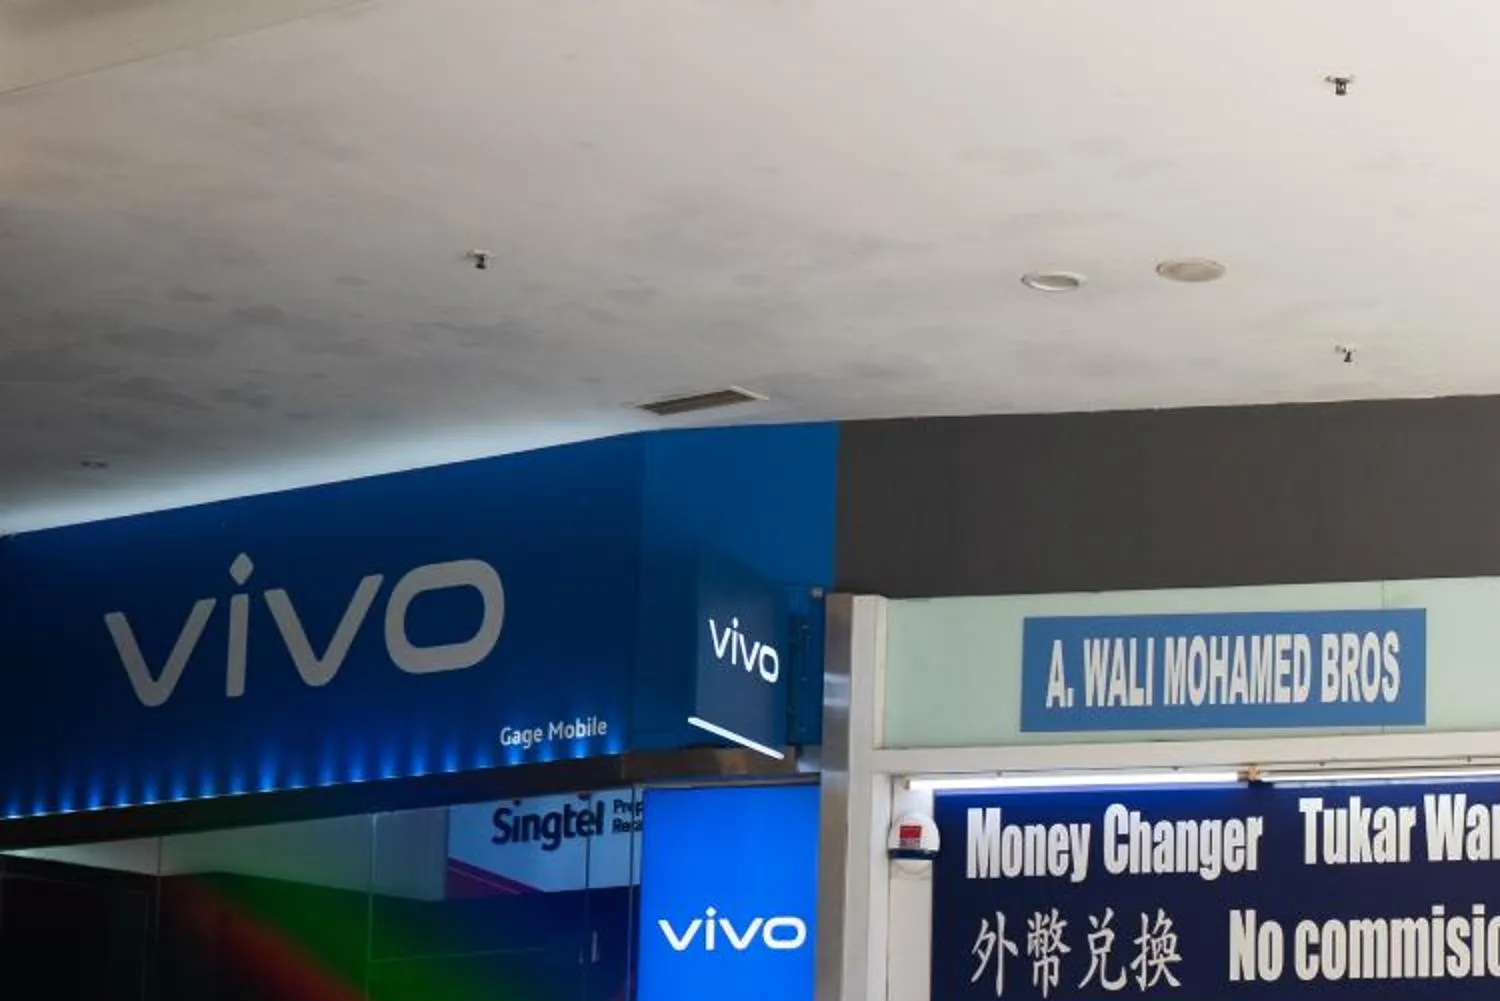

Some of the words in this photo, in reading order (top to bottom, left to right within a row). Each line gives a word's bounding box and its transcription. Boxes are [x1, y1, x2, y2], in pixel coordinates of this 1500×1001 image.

[104, 552, 505, 706] vivo
[708, 618, 780, 683] vivo
[1046, 638, 1074, 708] A.
[1083, 635, 1155, 707] WALI
[1163, 631, 1311, 706] MOHAMED
[1321, 629, 1400, 704] BROS
[500, 726, 543, 749] Gage
[548, 717, 609, 740] Mobile
[492, 800, 604, 851] Singtel
[966, 806, 1090, 882] Money
[1103, 802, 1264, 881] Changer
[1299, 796, 1417, 865] Tukar
[658, 906, 807, 951] vivo
[1228, 908, 1283, 982] No
